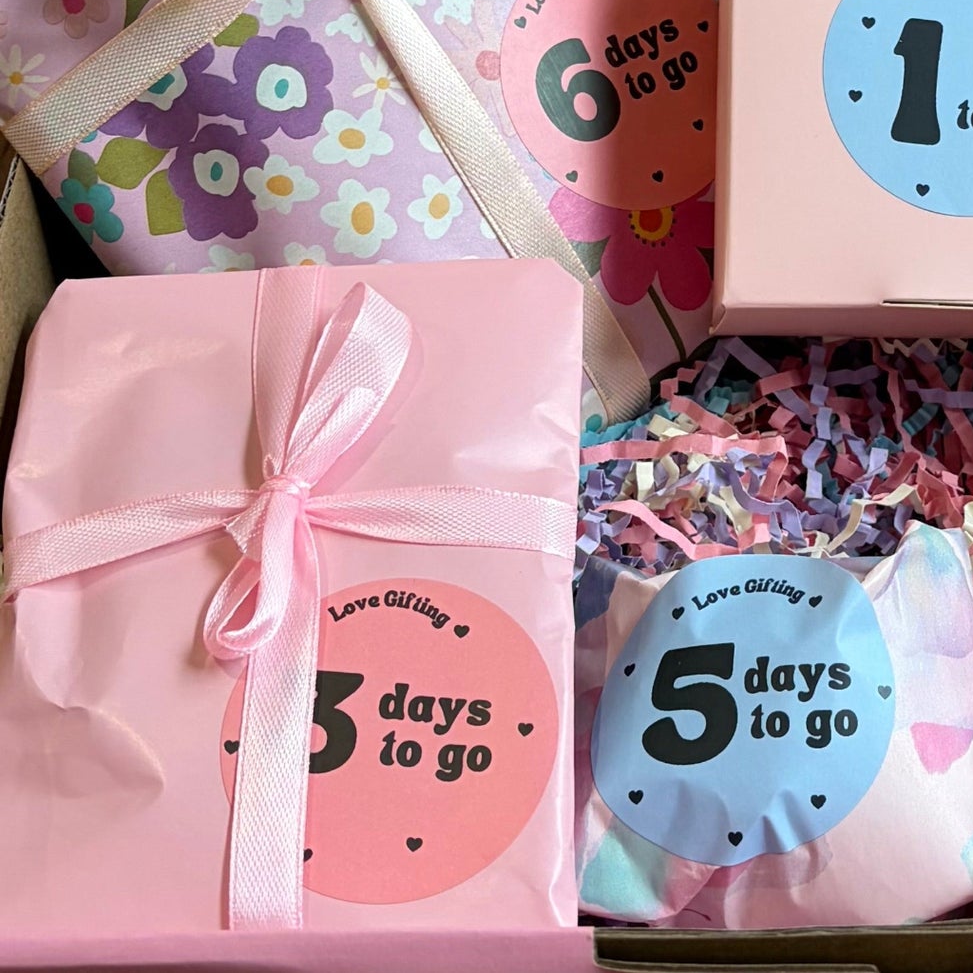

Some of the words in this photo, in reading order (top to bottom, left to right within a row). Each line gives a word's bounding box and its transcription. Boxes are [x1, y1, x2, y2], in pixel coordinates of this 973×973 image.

[604, 18, 680, 69] days
[535, 37, 621, 142] 6
[624, 71, 657, 100] to
[660, 49, 698, 90] go
[890, 17, 944, 146] 1
[327, 595, 381, 622] Love
[383, 590, 451, 629] Gifting
[691, 584, 741, 611] Love
[744, 578, 806, 605] Gifting
[642, 642, 738, 766] 5
[743, 656, 852, 703] days
[309, 669, 365, 775] 3
[378, 682, 492, 736] days
[750, 704, 790, 739] to
[805, 709, 858, 749] go
[379, 730, 423, 768] to
[435, 744, 492, 783] go
